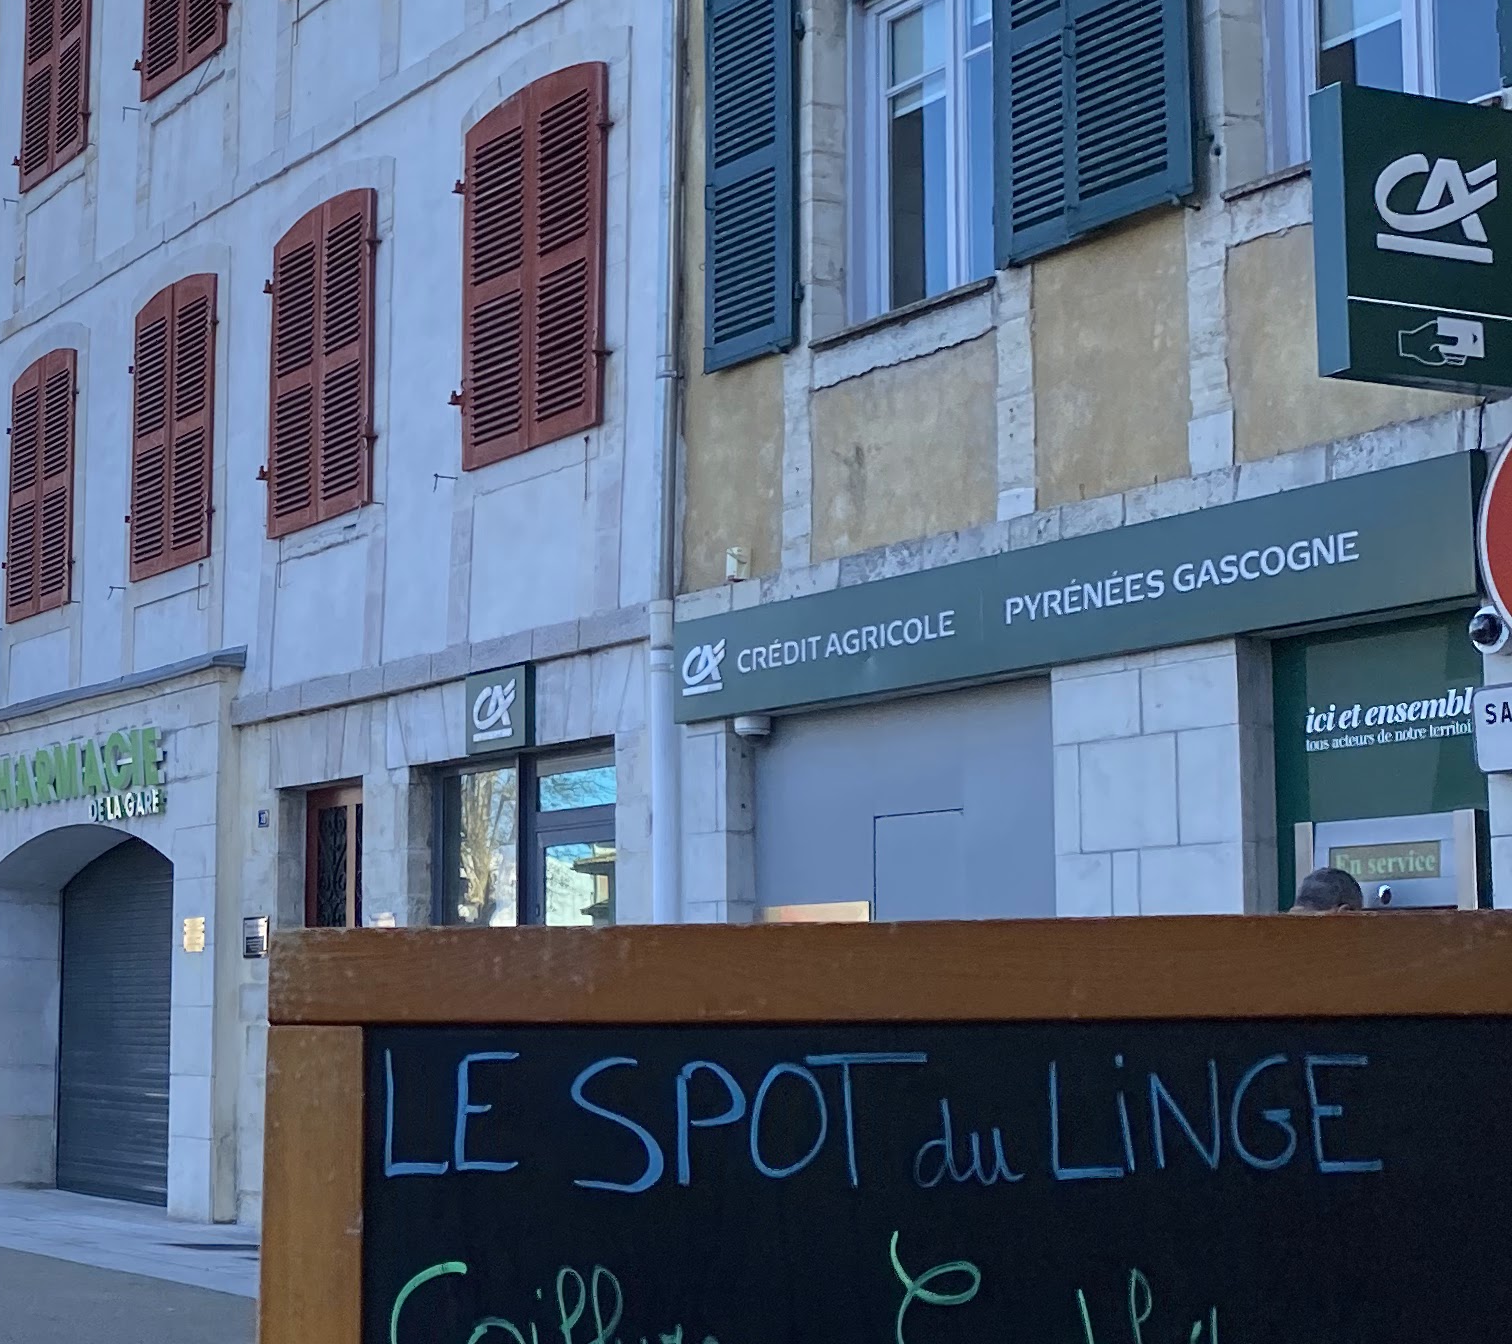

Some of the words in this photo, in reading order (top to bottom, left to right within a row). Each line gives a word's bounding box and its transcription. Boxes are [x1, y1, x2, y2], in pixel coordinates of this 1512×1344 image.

[737, 637, 824, 674] CRÉDIT
[826, 610, 956, 662] AGRICOLE
[1004, 568, 1166, 626] PYRÉNÉES
[1172, 530, 1360, 594] GASCOGNE
[1305, 704, 1337, 734] ici
[1338, 704, 1362, 729] et
[1306, 738, 1329, 752] tous
[1331, 731, 1376, 749] acteurs
[1377, 729, 1393, 744] de
[1395, 725, 1427, 742] notre
[88, 797, 106, 823] DE
[106, 794, 123, 820] LA
[124, 787, 161, 818] GARE
[1365, 850, 1436, 875] service
[382, 1047, 520, 1179] LE
[569, 1052, 928, 1194] SPOT
[912, 1097, 1025, 1187] du
